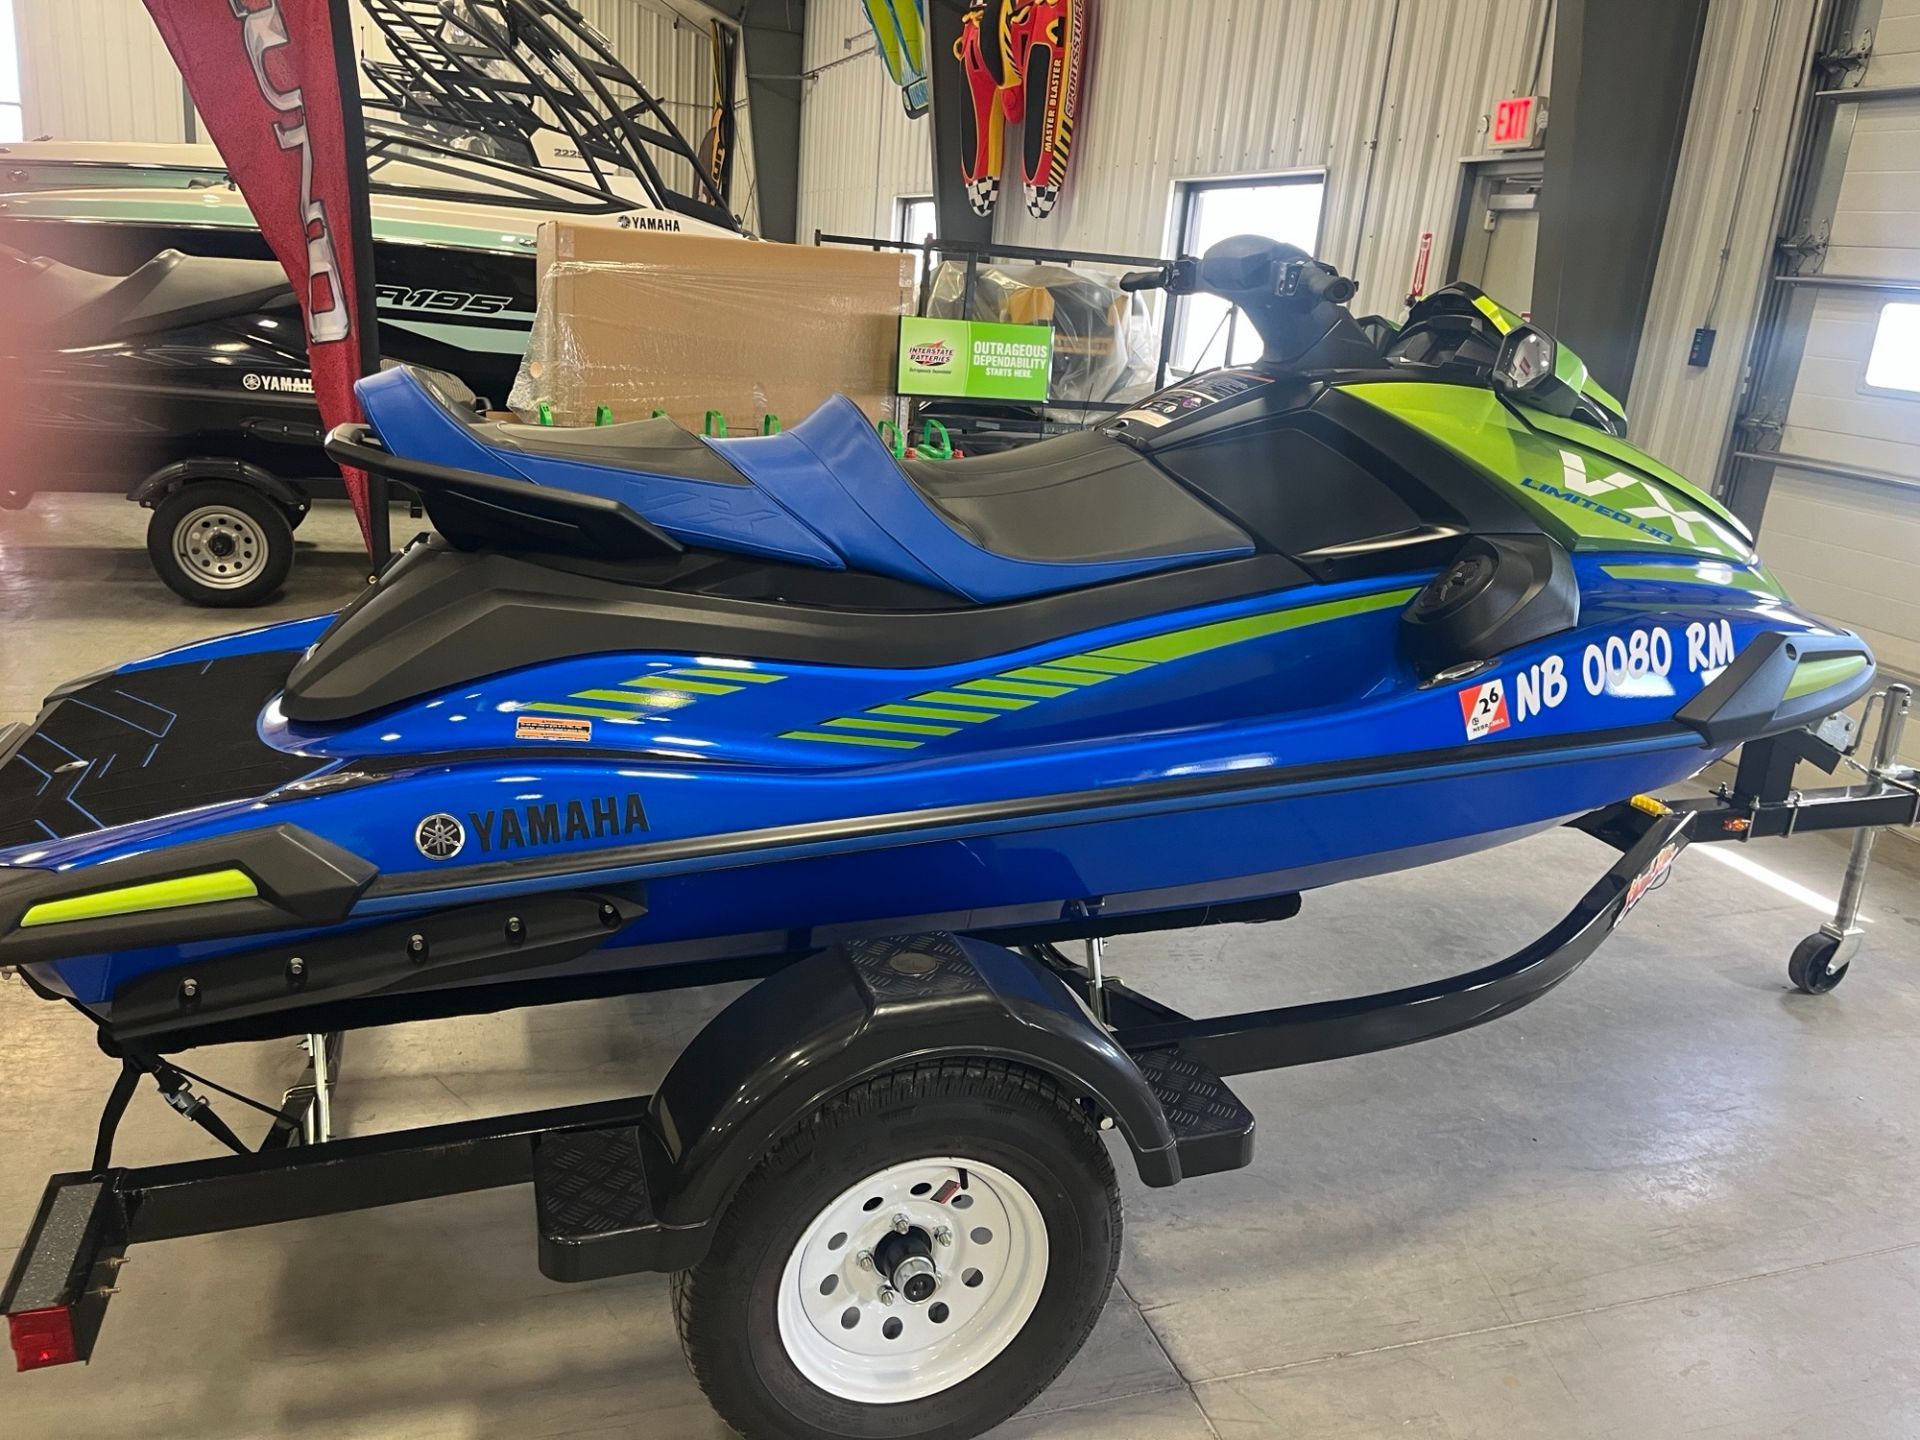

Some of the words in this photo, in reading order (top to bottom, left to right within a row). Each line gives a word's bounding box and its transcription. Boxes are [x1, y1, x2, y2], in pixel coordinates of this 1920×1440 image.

[1049, 59, 1062, 107] BLASTER
[1045, 109, 1055, 152] MASTER
[1494, 99, 1531, 142] EXIT
[632, 217, 680, 231] YAMAHA
[909, 347, 953, 356] INTERSTATE
[973, 355, 1047, 370] DEPENDABILITY
[974, 341, 1048, 358] OUTRAGEOUS
[261, 375, 315, 393] YAMAH
[985, 367, 1012, 377] STARTS
[1521, 477, 1632, 525] LIMITED
[1559, 449, 1697, 544] VX
[1516, 655, 1568, 722] NB
[1582, 627, 1672, 696] 0080
[1686, 619, 1735, 673] RM
[1479, 687, 1499, 715] 26
[469, 793, 650, 851] YAMAHA
